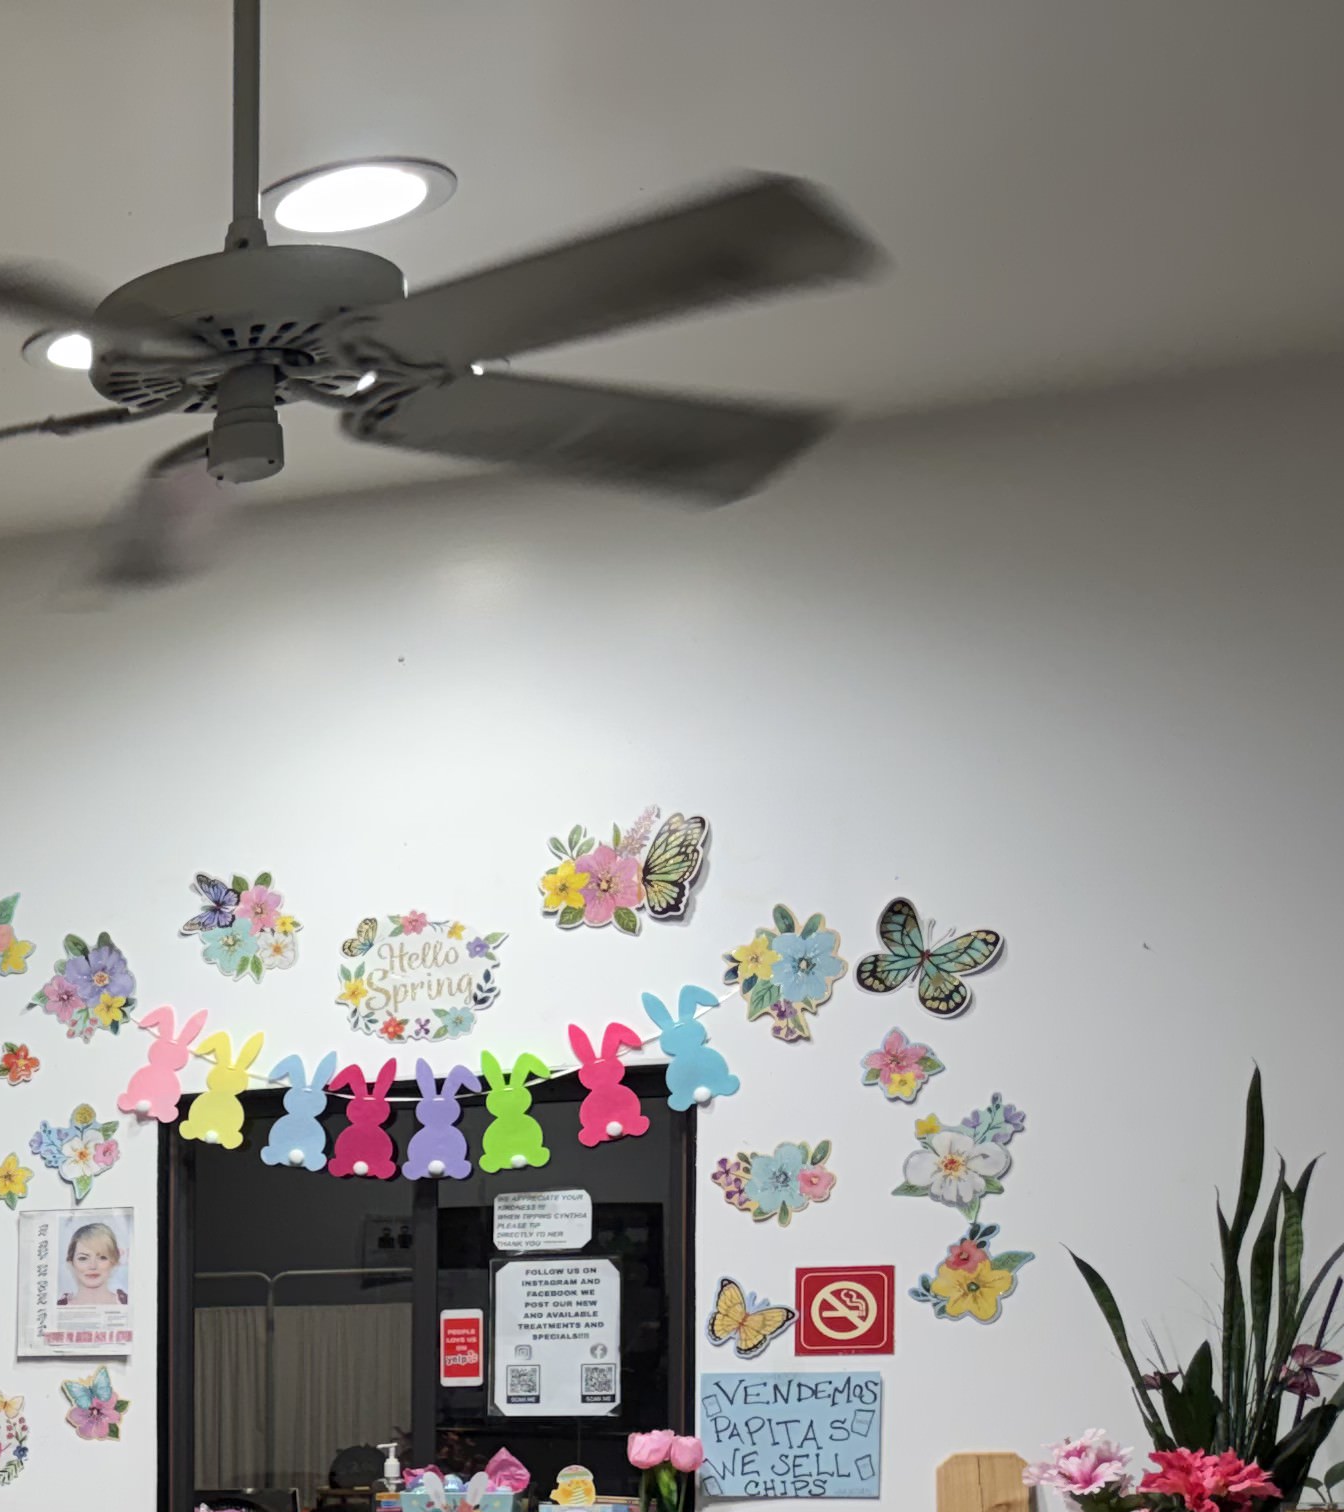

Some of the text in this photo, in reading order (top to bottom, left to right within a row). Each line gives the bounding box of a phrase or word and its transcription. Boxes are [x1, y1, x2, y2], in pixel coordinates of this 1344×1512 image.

[377, 940, 459, 973] Hello
[365, 968, 474, 1012] Spring
[525, 1268, 563, 1276] FOLLOW
[517, 1322, 581, 1330] TREATMENTS
[445, 1354, 467, 1366] yelp
[703, 1448, 851, 1480] WE SELL
[744, 1479, 828, 1497] CHIPS
